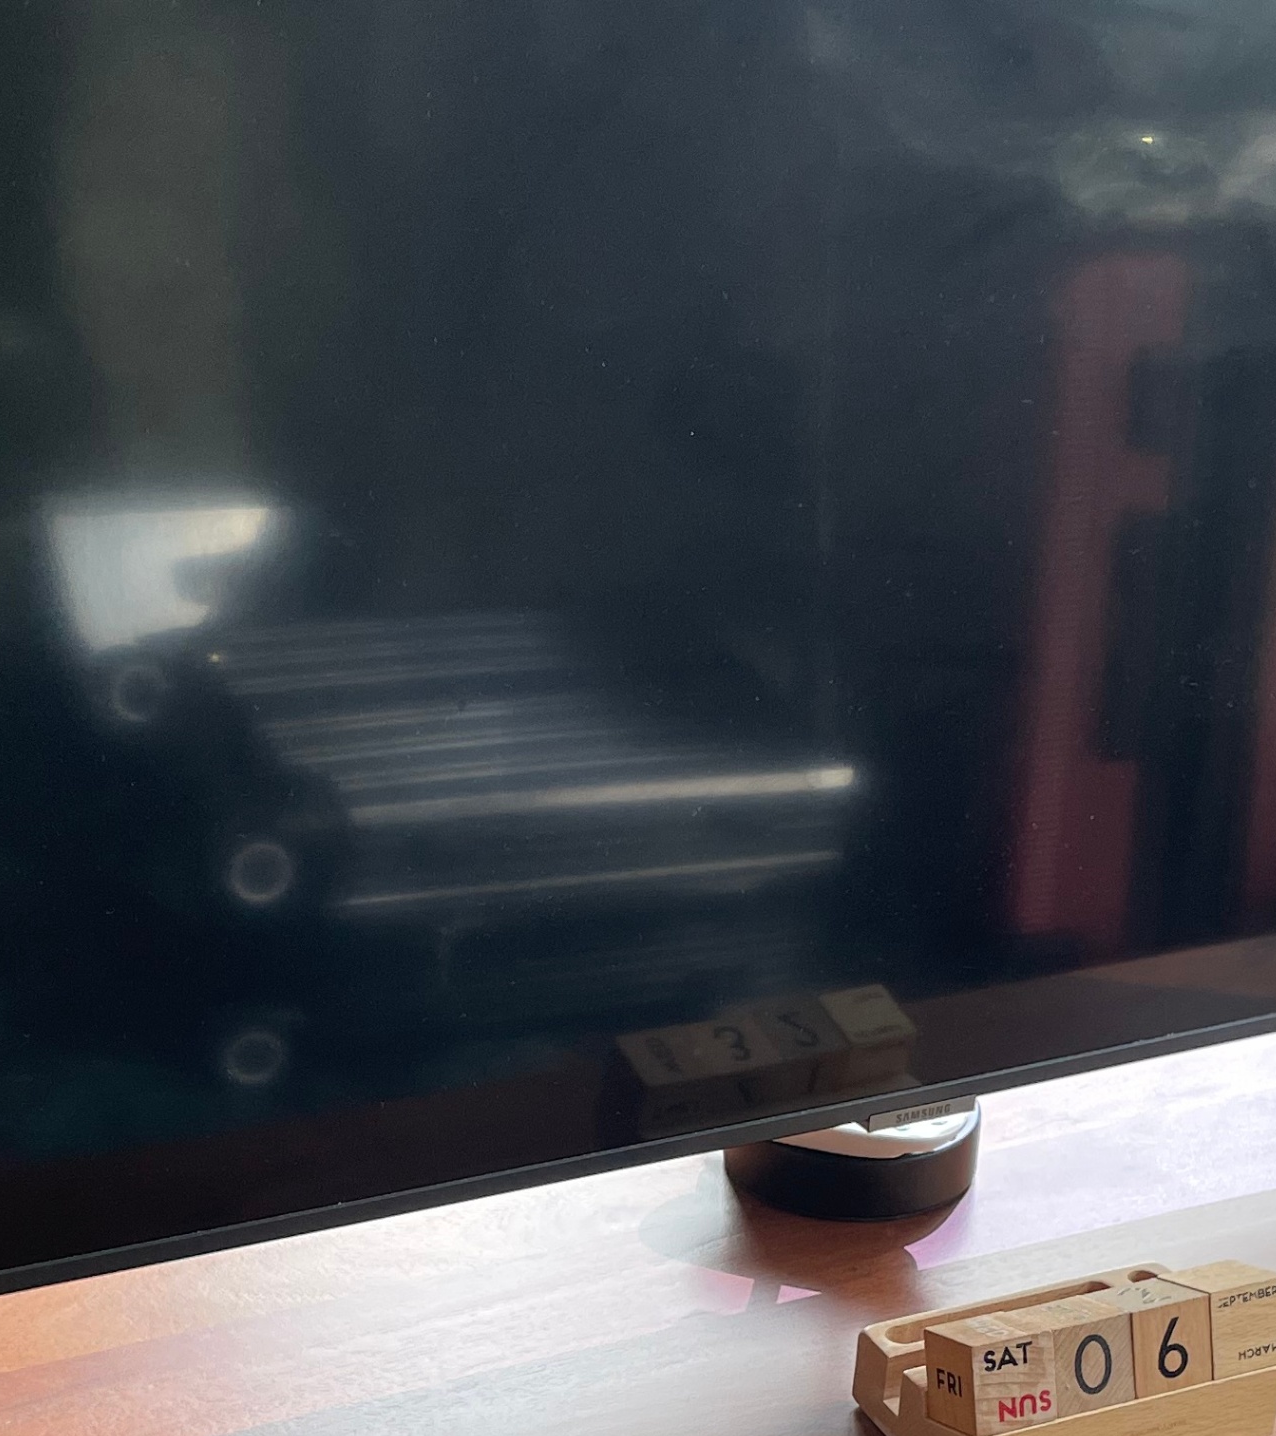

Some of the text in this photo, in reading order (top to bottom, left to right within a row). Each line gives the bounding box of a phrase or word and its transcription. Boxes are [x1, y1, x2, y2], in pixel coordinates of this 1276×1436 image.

[895, 1103, 952, 1124] SAMSUNG
[983, 1340, 1033, 1373] SAT
[1157, 1316, 1189, 1379] 6
[936, 1367, 963, 1398] FRI
[998, 1389, 1052, 1423] SUN
